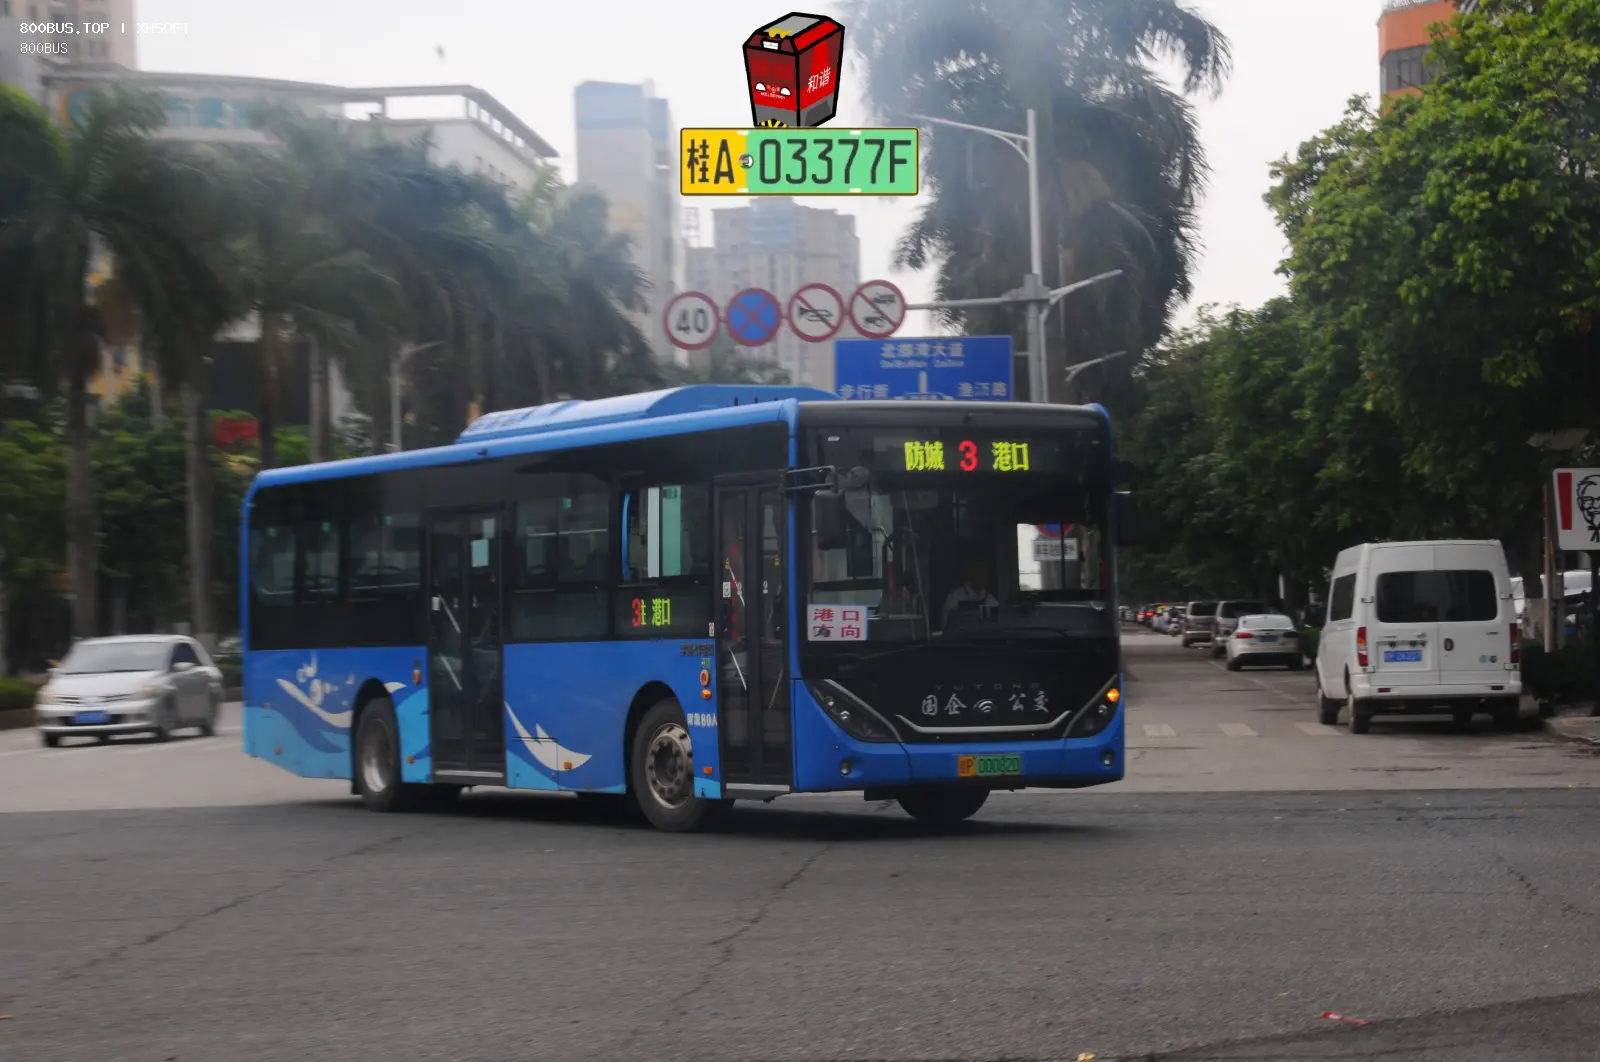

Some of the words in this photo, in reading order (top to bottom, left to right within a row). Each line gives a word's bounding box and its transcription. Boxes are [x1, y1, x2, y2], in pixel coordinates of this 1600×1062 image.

[675, 308, 709, 335] 40
[904, 440, 945, 472] 防城
[958, 440, 978, 471] 3
[991, 441, 1030, 472] 港口
[631, 597, 642, 628] 3
[652, 597, 671, 627] 港口
[812, 608, 860, 622] 港口
[812, 624, 861, 639] 方向
